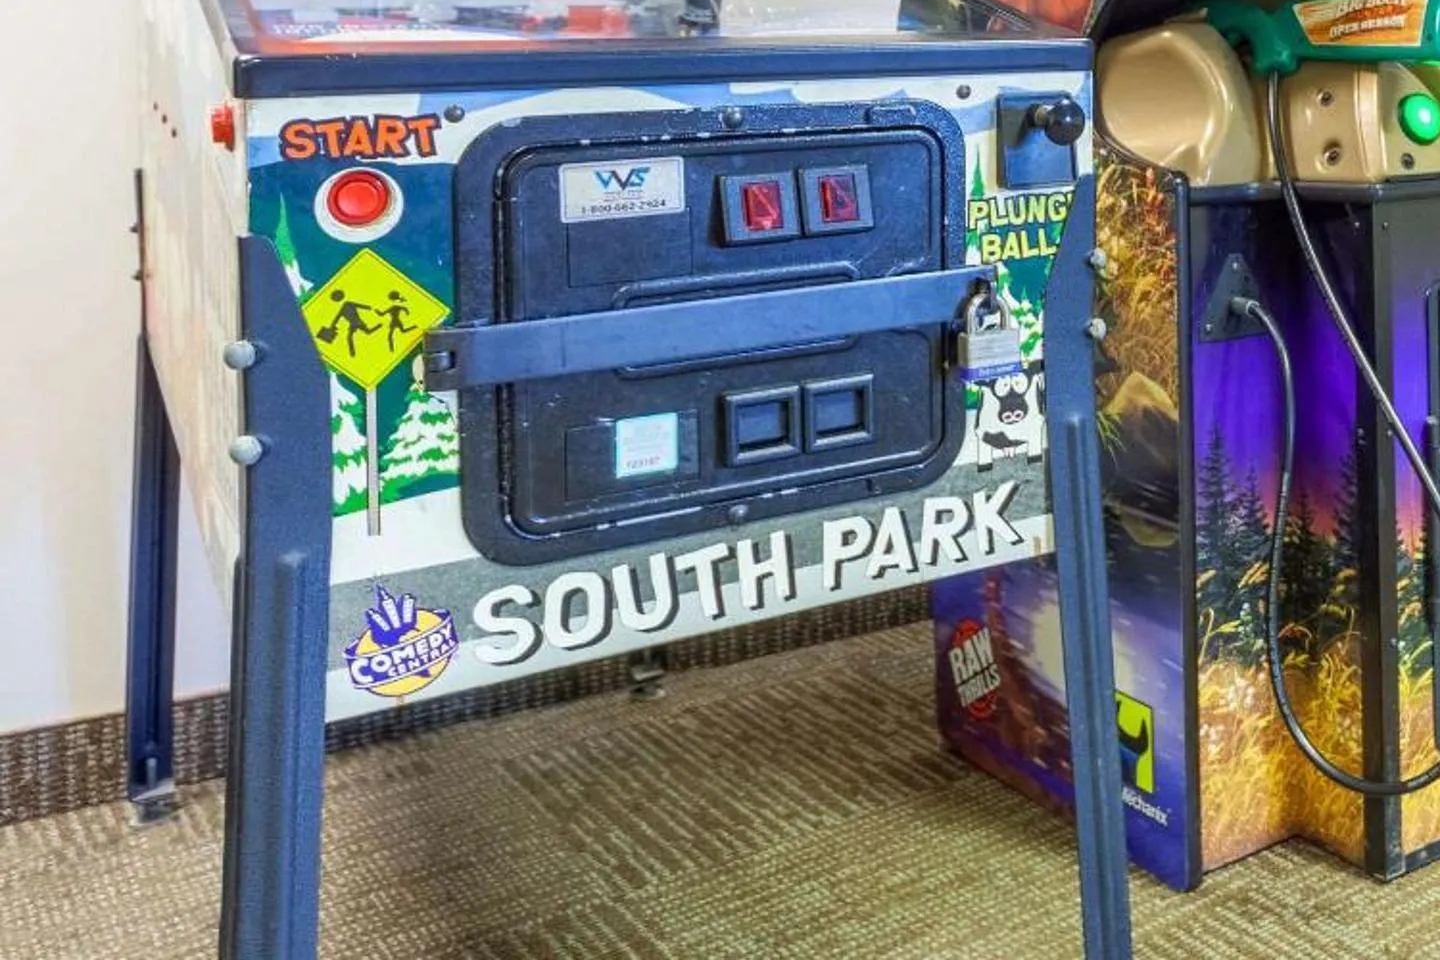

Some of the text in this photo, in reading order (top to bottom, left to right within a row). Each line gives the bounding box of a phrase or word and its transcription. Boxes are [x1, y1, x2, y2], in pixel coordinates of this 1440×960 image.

[281, 114, 442, 161] START
[967, 191, 1074, 231] PLUNG
[980, 229, 1062, 263] BALL
[472, 480, 1032, 665] SOUTH PARK
[351, 622, 452, 685] COMEDY
[388, 638, 456, 677] CENTRAL
[949, 626, 994, 685] RAW
